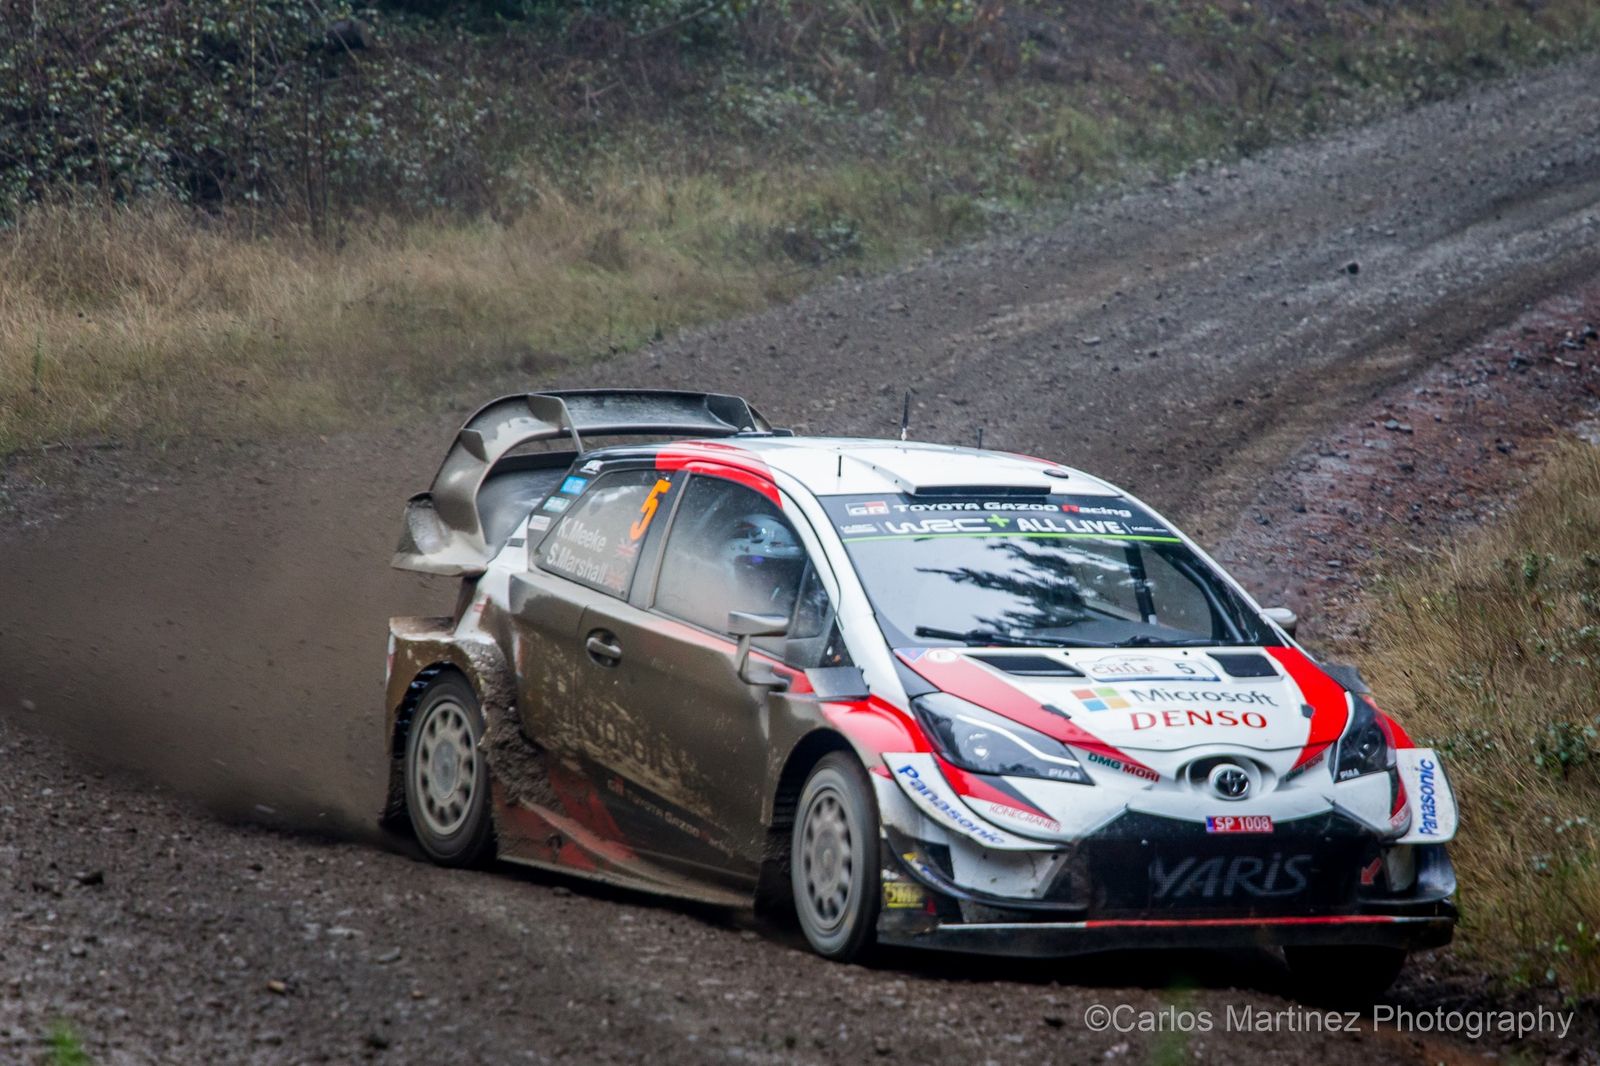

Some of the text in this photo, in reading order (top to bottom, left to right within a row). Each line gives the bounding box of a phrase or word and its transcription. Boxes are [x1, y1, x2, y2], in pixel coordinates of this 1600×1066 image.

[629, 479, 672, 541] 5
[893, 502, 981, 513] TOYOTA
[556, 516, 607, 552] K.Meeke
[1016, 517, 1067, 532] ALL
[1065, 519, 1126, 534] LIVE
[547, 543, 609, 584] S.Marshall
[1174, 662, 1196, 675] 5
[1130, 688, 1280, 707] Microsoft
[1129, 710, 1268, 731] DENSO
[1049, 768, 1080, 780] PIAA
[1087, 752, 1161, 783] DMG MORI
[897, 764, 1005, 844] Panasonic
[1415, 758, 1439, 836] Panasonic
[1215, 816, 1270, 831] SP 1008
